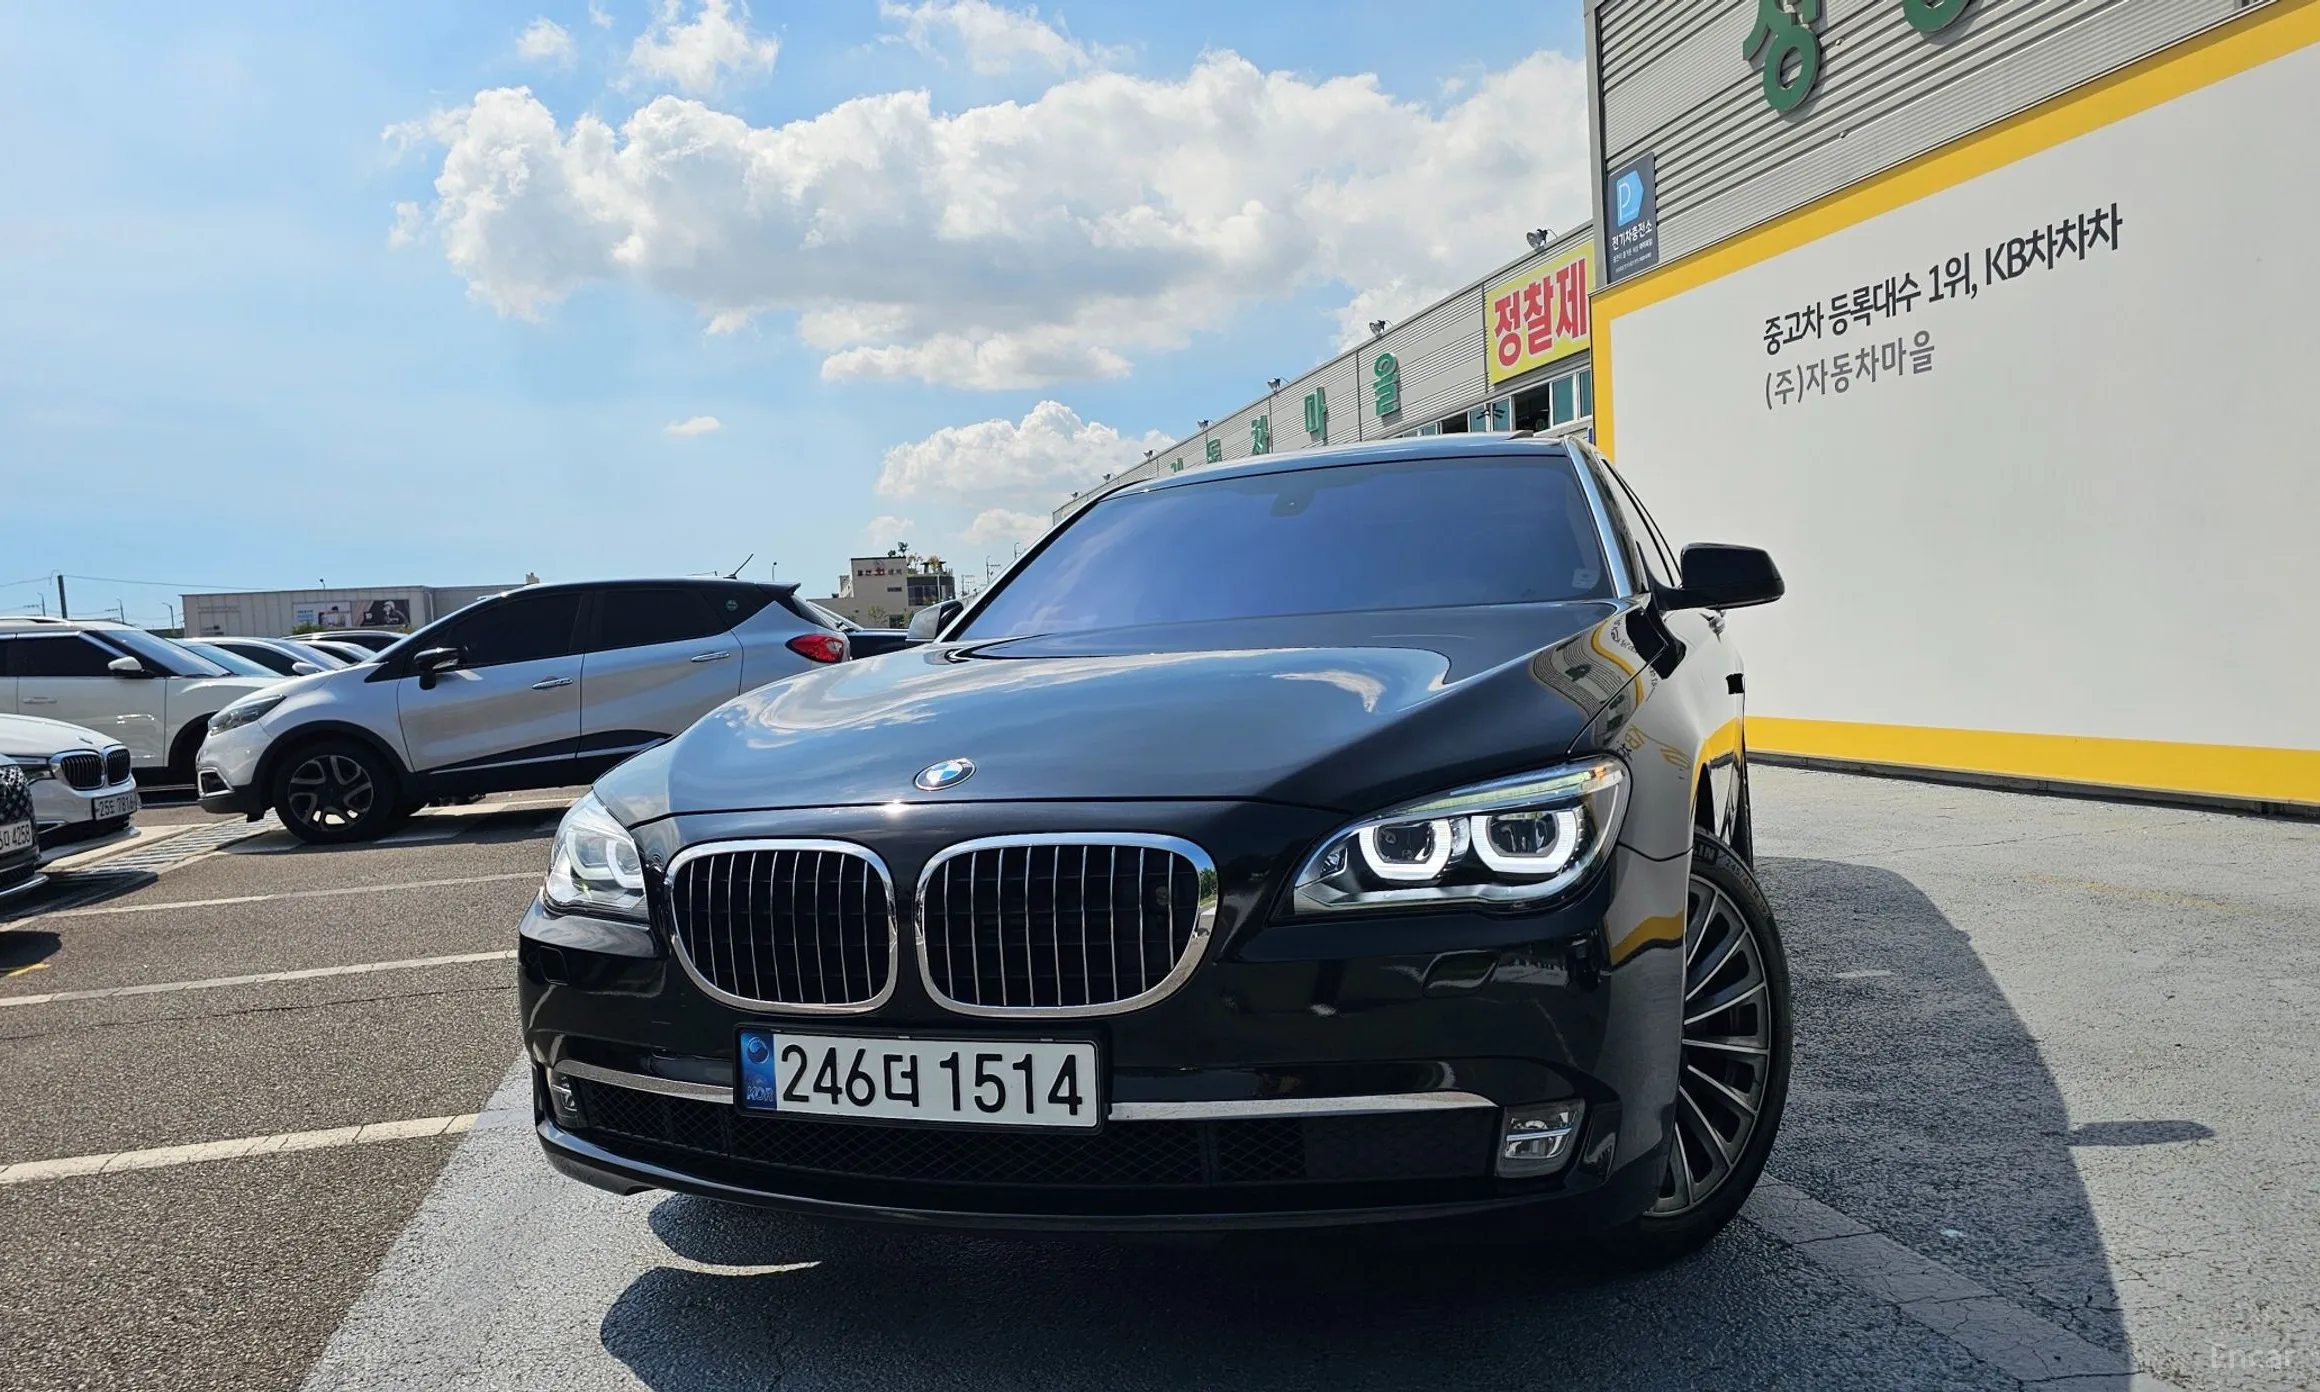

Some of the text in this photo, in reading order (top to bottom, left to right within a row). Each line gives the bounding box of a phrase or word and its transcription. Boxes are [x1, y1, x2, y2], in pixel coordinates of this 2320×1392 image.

[1611, 219, 1653, 251] 전기차충전소
[1494, 258, 1587, 367] 정찰제
[1763, 202, 2123, 355] 중고차 등록대수 1위, KB차차차
[1765, 330, 1935, 410] (주)자동차마을
[781, 1044, 1083, 1116] 246더 1514
